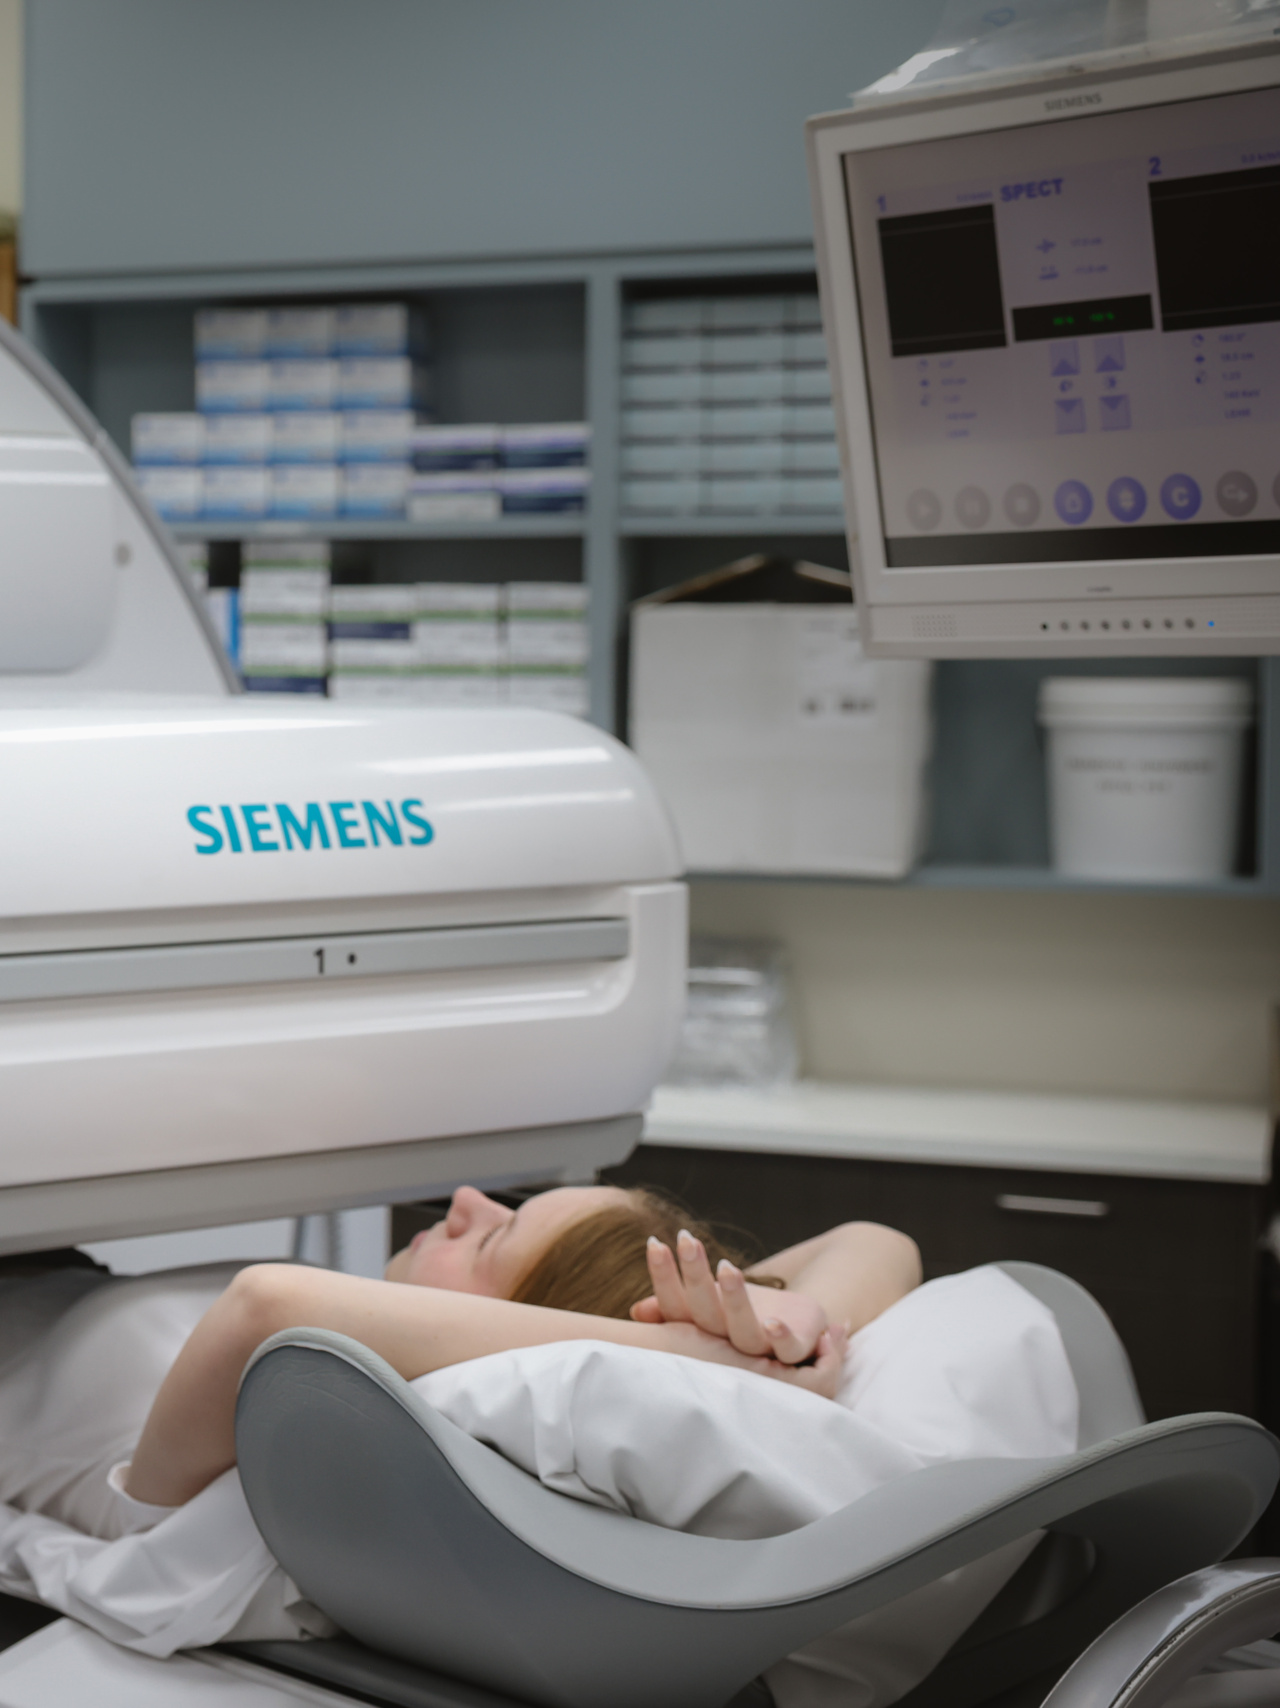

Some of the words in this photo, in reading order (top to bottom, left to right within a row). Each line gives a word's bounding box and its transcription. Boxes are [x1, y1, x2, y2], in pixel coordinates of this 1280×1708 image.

[1044, 93, 1102, 112] SIEMENS
[1149, 156, 1162, 175] 2
[1001, 178, 1063, 202] SPECT
[876, 194, 887, 212] 1
[186, 798, 435, 855] SIEMENS
[313, 947, 325, 974] 1
